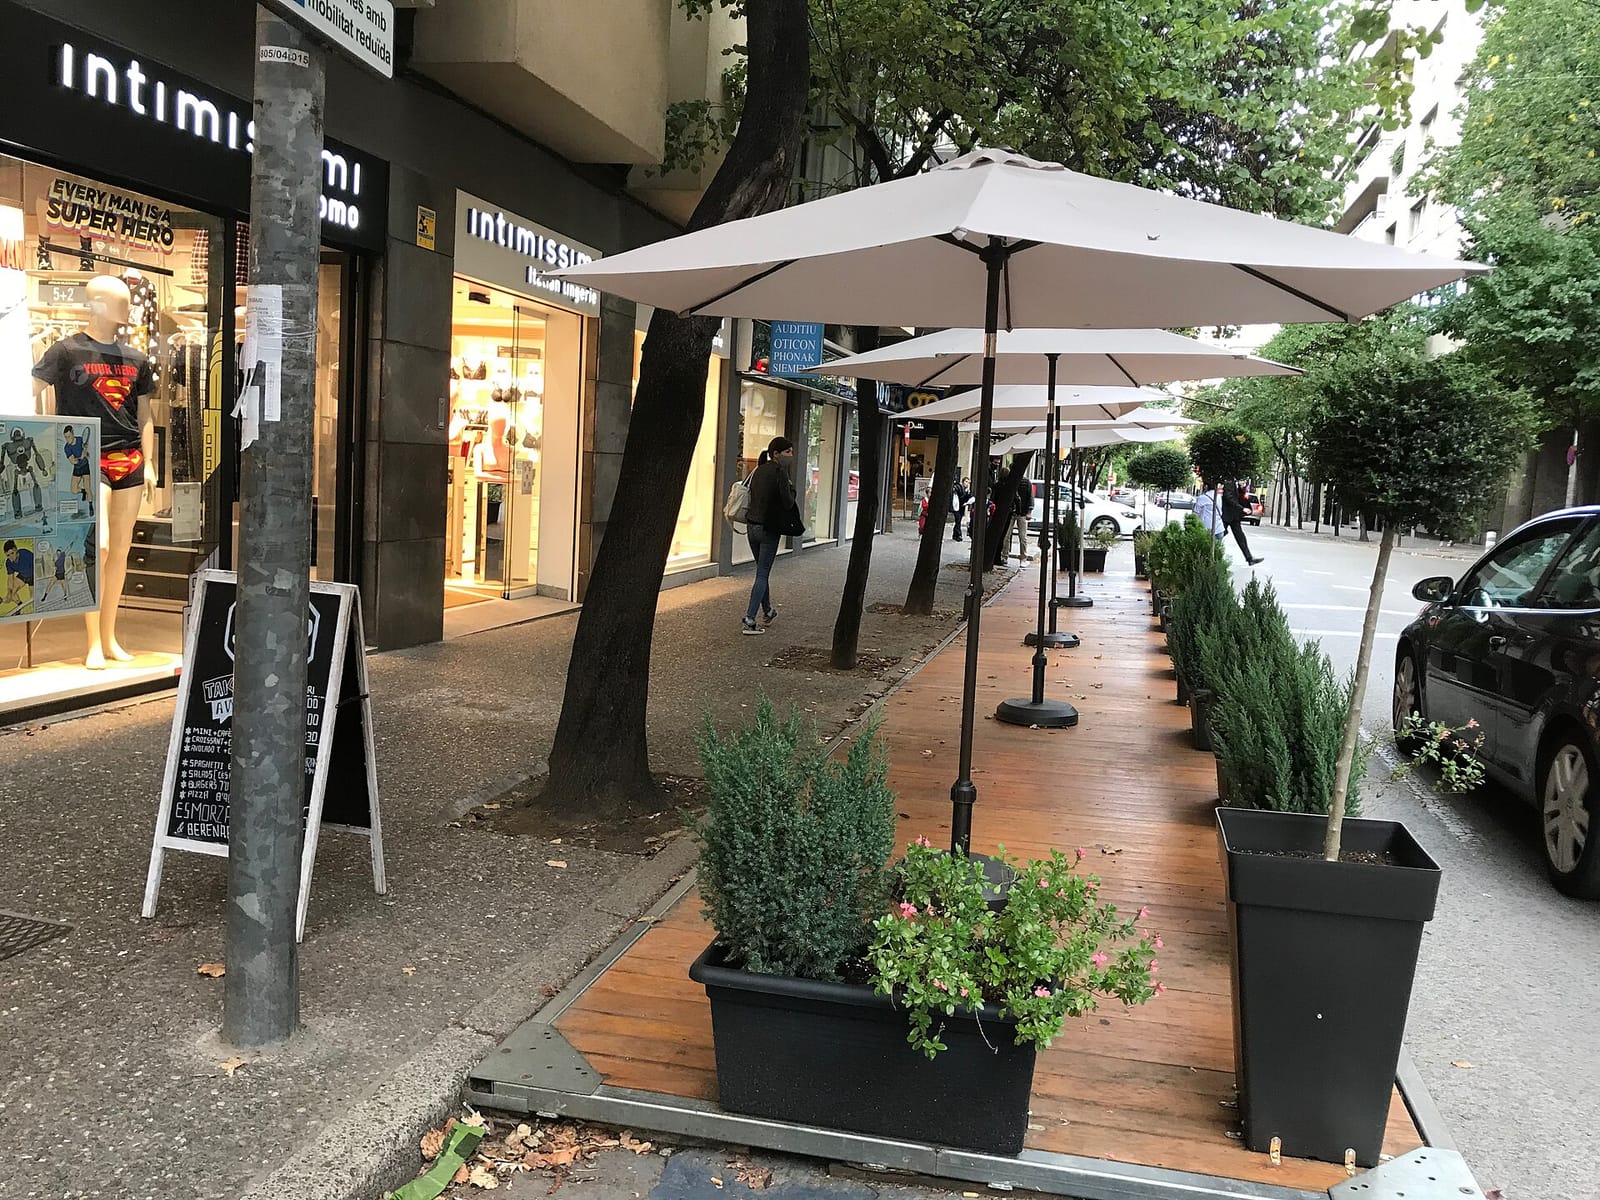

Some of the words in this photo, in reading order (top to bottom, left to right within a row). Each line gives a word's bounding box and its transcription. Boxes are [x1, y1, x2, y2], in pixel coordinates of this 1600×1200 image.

[366, 5, 387, 32] amb
[356, 28, 391, 65] reduïda
[52, 178, 107, 208] EVERY
[108, 193, 144, 216] MAN
[145, 203, 159, 220] IS
[159, 208, 171, 223] A
[47, 198, 118, 236] SUPER
[120, 214, 175, 249] HERO
[775, 323, 817, 335] AUDITIU
[773, 338, 816, 350] OTICON
[773, 351, 815, 362] PHONAK
[83, 362, 112, 375] YOUR
[187, 790, 209, 800] PIZZA
